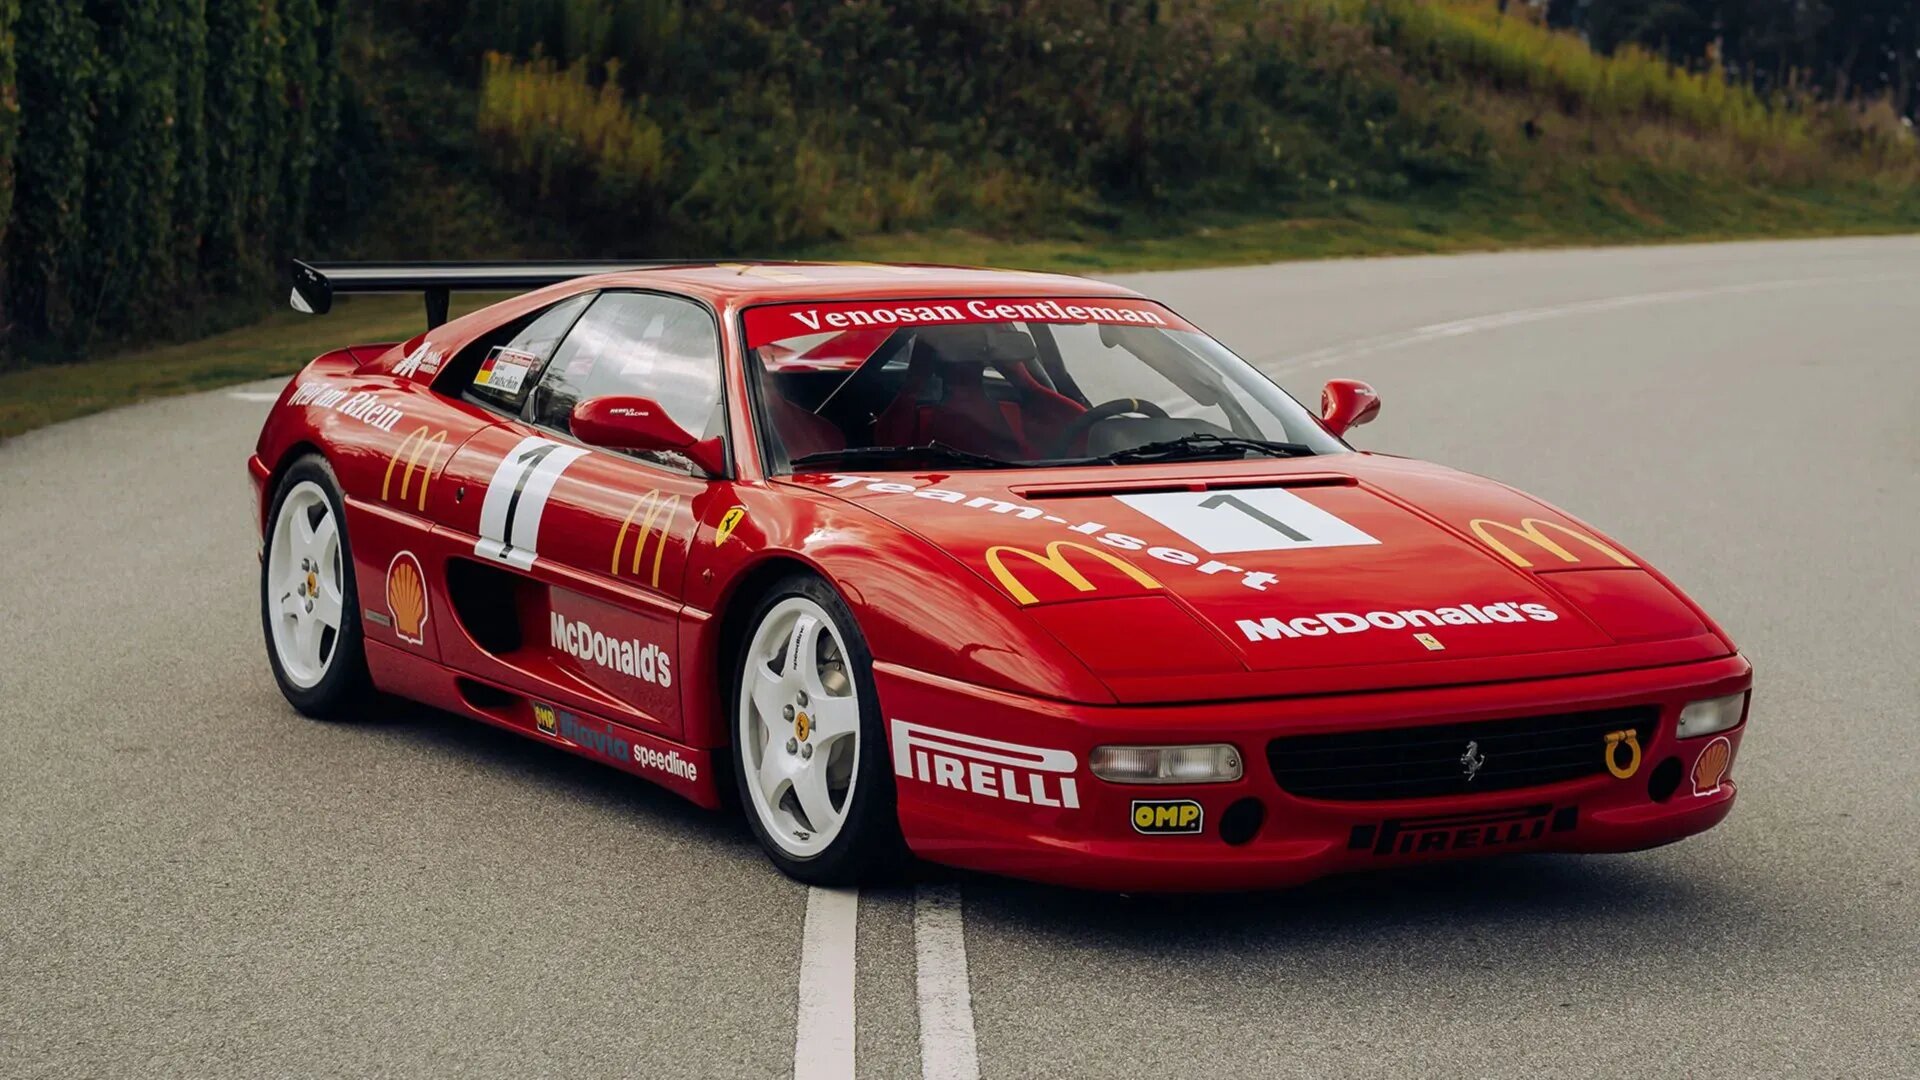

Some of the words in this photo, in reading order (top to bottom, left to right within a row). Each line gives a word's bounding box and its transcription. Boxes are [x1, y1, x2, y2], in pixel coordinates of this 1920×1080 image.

[790, 305, 966, 331] Venosan
[968, 300, 1166, 326] Gentleman
[336, 391, 403, 432] Rhein
[499, 444, 561, 559] 1
[1197, 494, 1313, 542] 1
[1235, 602, 1559, 642] McDonald's
[550, 611, 672, 688] McDonald's
[534, 704, 556, 729] OMP
[633, 743, 698, 782] speedline
[891, 718, 1080, 809] PIRELLI
[1135, 805, 1199, 827] OMP
[1373, 803, 1553, 856] PIRELLI
